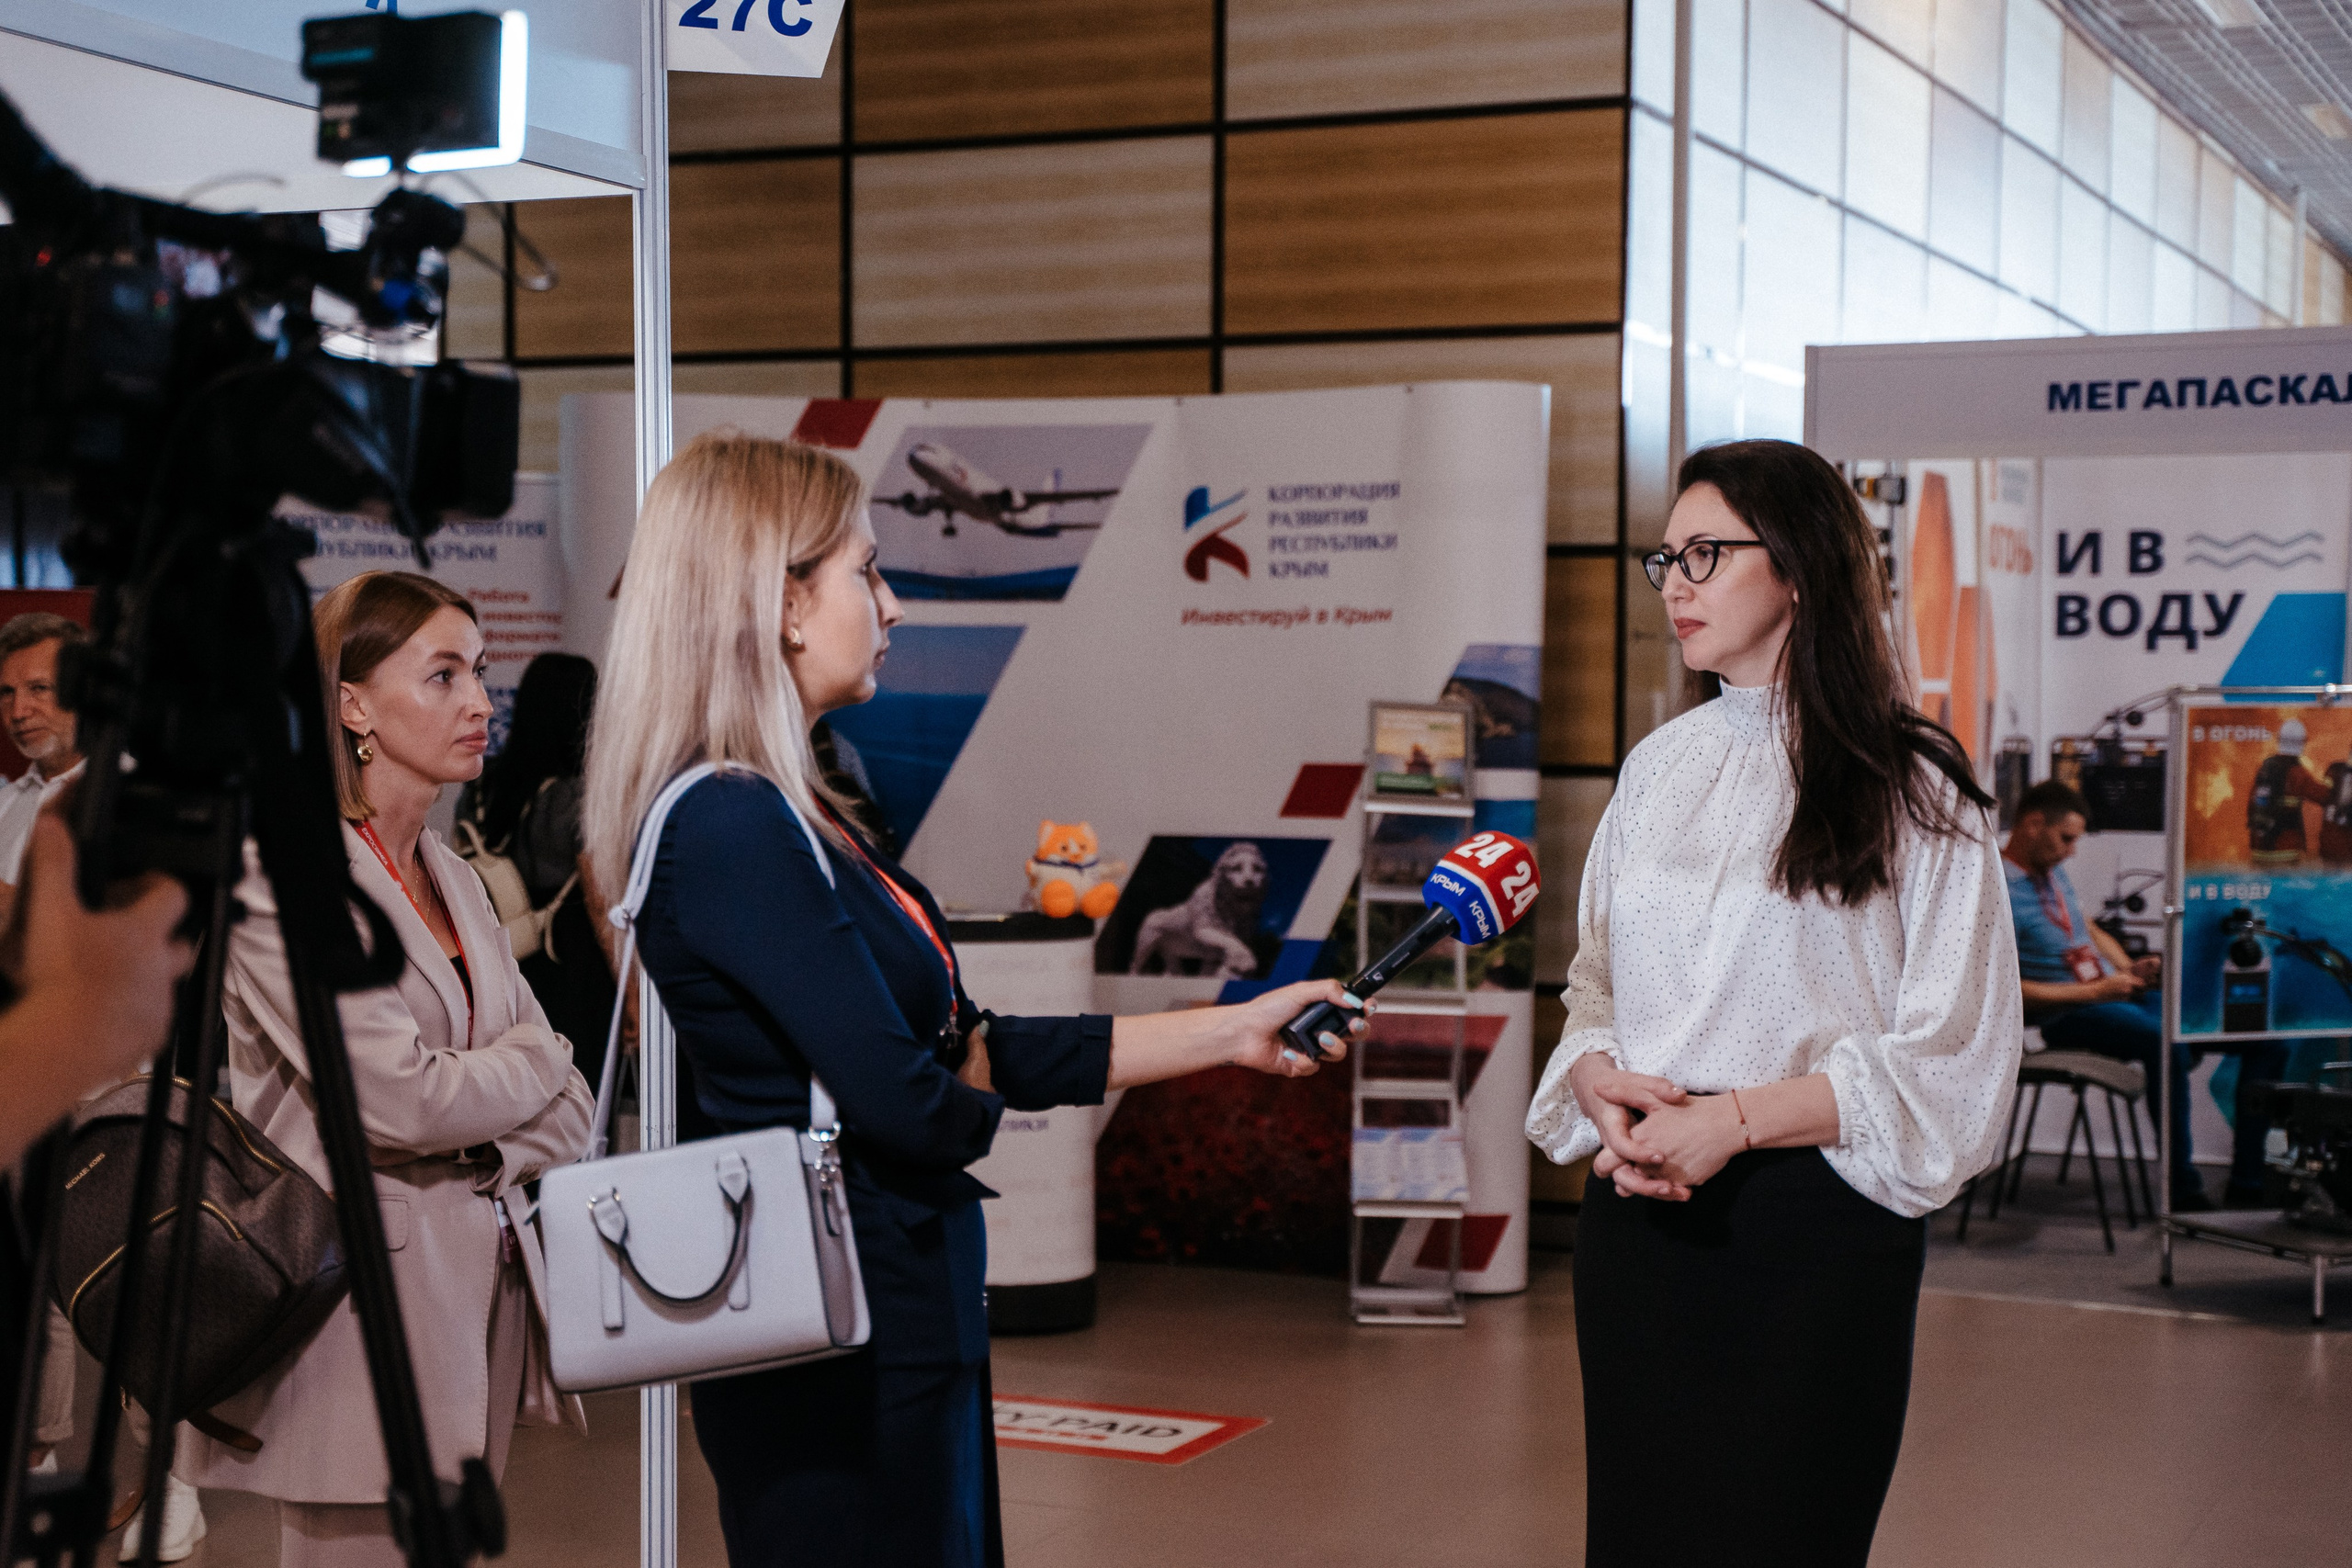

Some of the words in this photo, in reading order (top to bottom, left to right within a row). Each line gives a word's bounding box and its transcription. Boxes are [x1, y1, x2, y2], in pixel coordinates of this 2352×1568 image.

[1268, 482, 1400, 502] КОРПОРАЦИЯ
[1268, 510, 1368, 527] РАЗВИТИЯ
[1268, 534, 1398, 553] РЕСПУБЛИКИ
[2057, 530, 2101, 576] И
[2129, 530, 2165, 575] В
[1268, 561, 1329, 579] КРЫМ
[1181, 607, 1311, 629] Инвестируй
[1334, 607, 1394, 627] Крым
[2055, 592, 2245, 652] ВОДУ
[1454, 833, 1515, 869] 24
[1430, 873, 1466, 897] КРЫМ
[1500, 861, 1541, 919] 24
[1469, 900, 1491, 939] КРЫМ
[65, 1167, 90, 1190] MICHAEL
[88, 1152, 106, 1169] KORS
